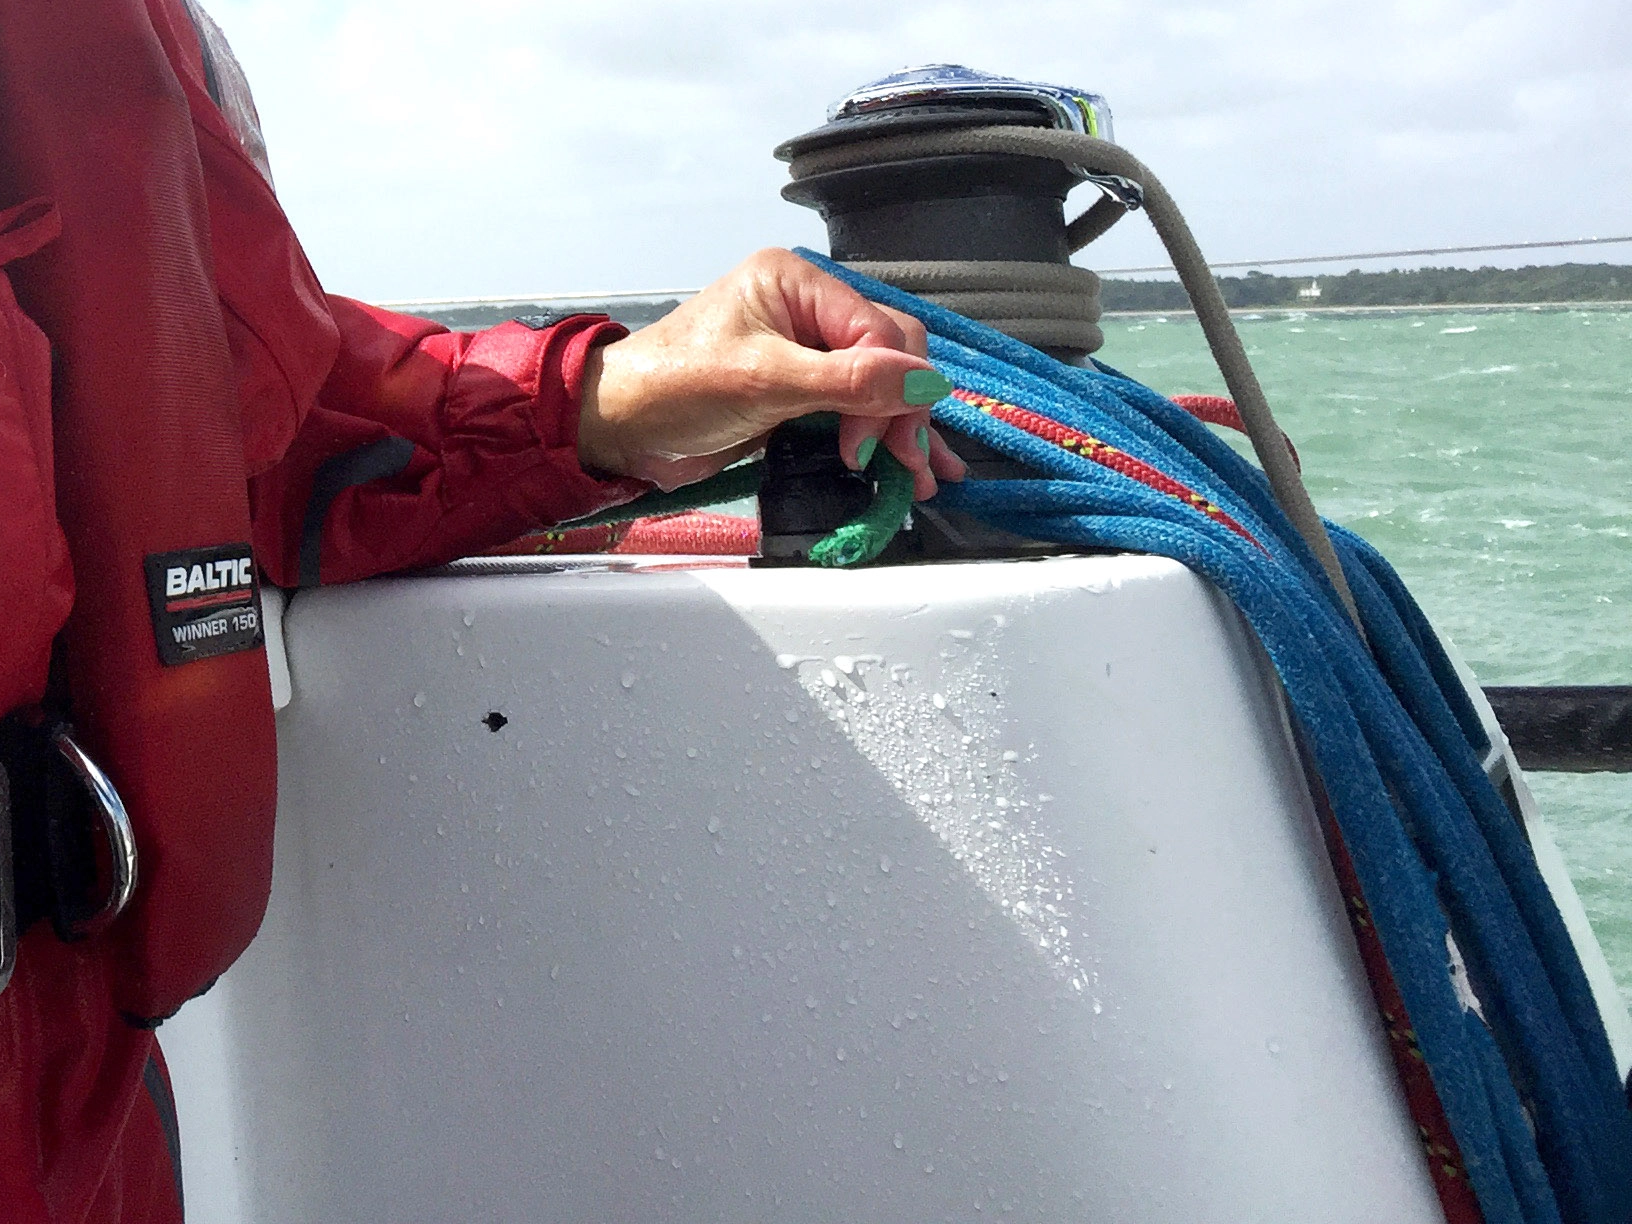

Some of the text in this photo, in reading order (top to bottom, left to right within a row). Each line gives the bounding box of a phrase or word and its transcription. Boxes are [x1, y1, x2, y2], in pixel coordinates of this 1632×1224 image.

[166, 557, 252, 596] BALTIC
[172, 613, 257, 643] WINNER 150
